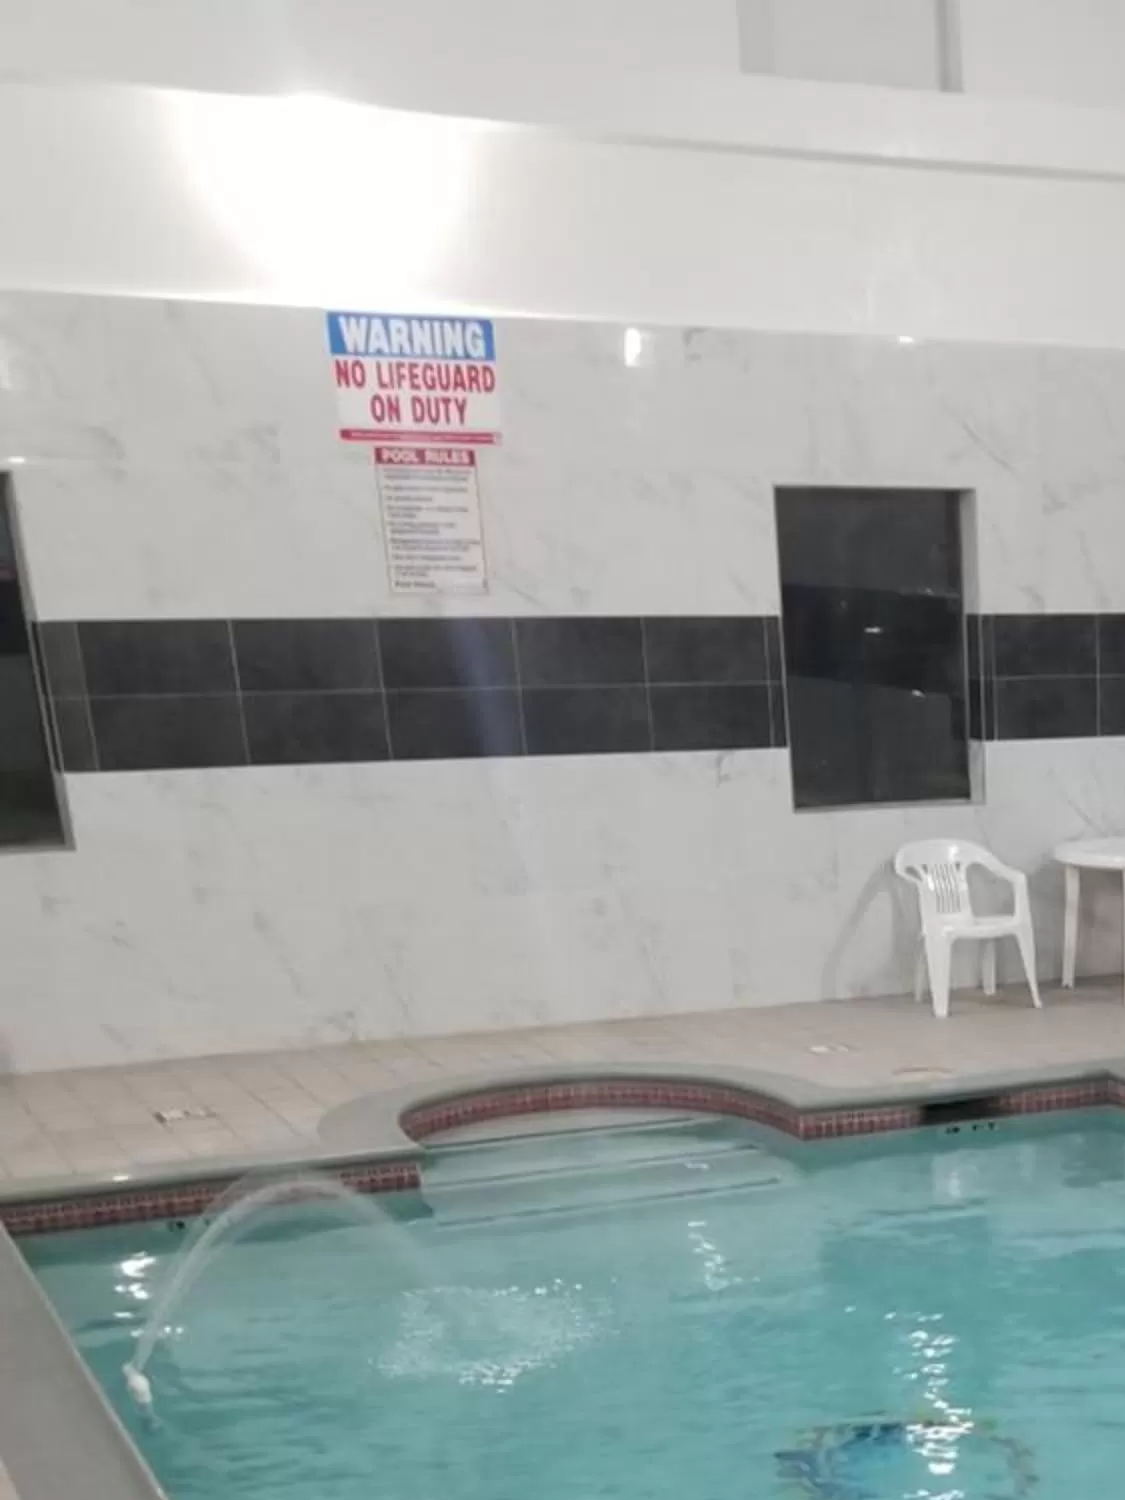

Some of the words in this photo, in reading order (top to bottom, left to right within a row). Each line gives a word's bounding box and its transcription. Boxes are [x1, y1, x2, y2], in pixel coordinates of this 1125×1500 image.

[337, 315, 487, 358] WARNING
[334, 359, 366, 389] NO
[376, 361, 496, 393] LIFEGUARD
[370, 394, 401, 424] ON
[411, 396, 468, 425] DUTY
[381, 448, 420, 463] POOL
[424, 450, 471, 465] RULES
